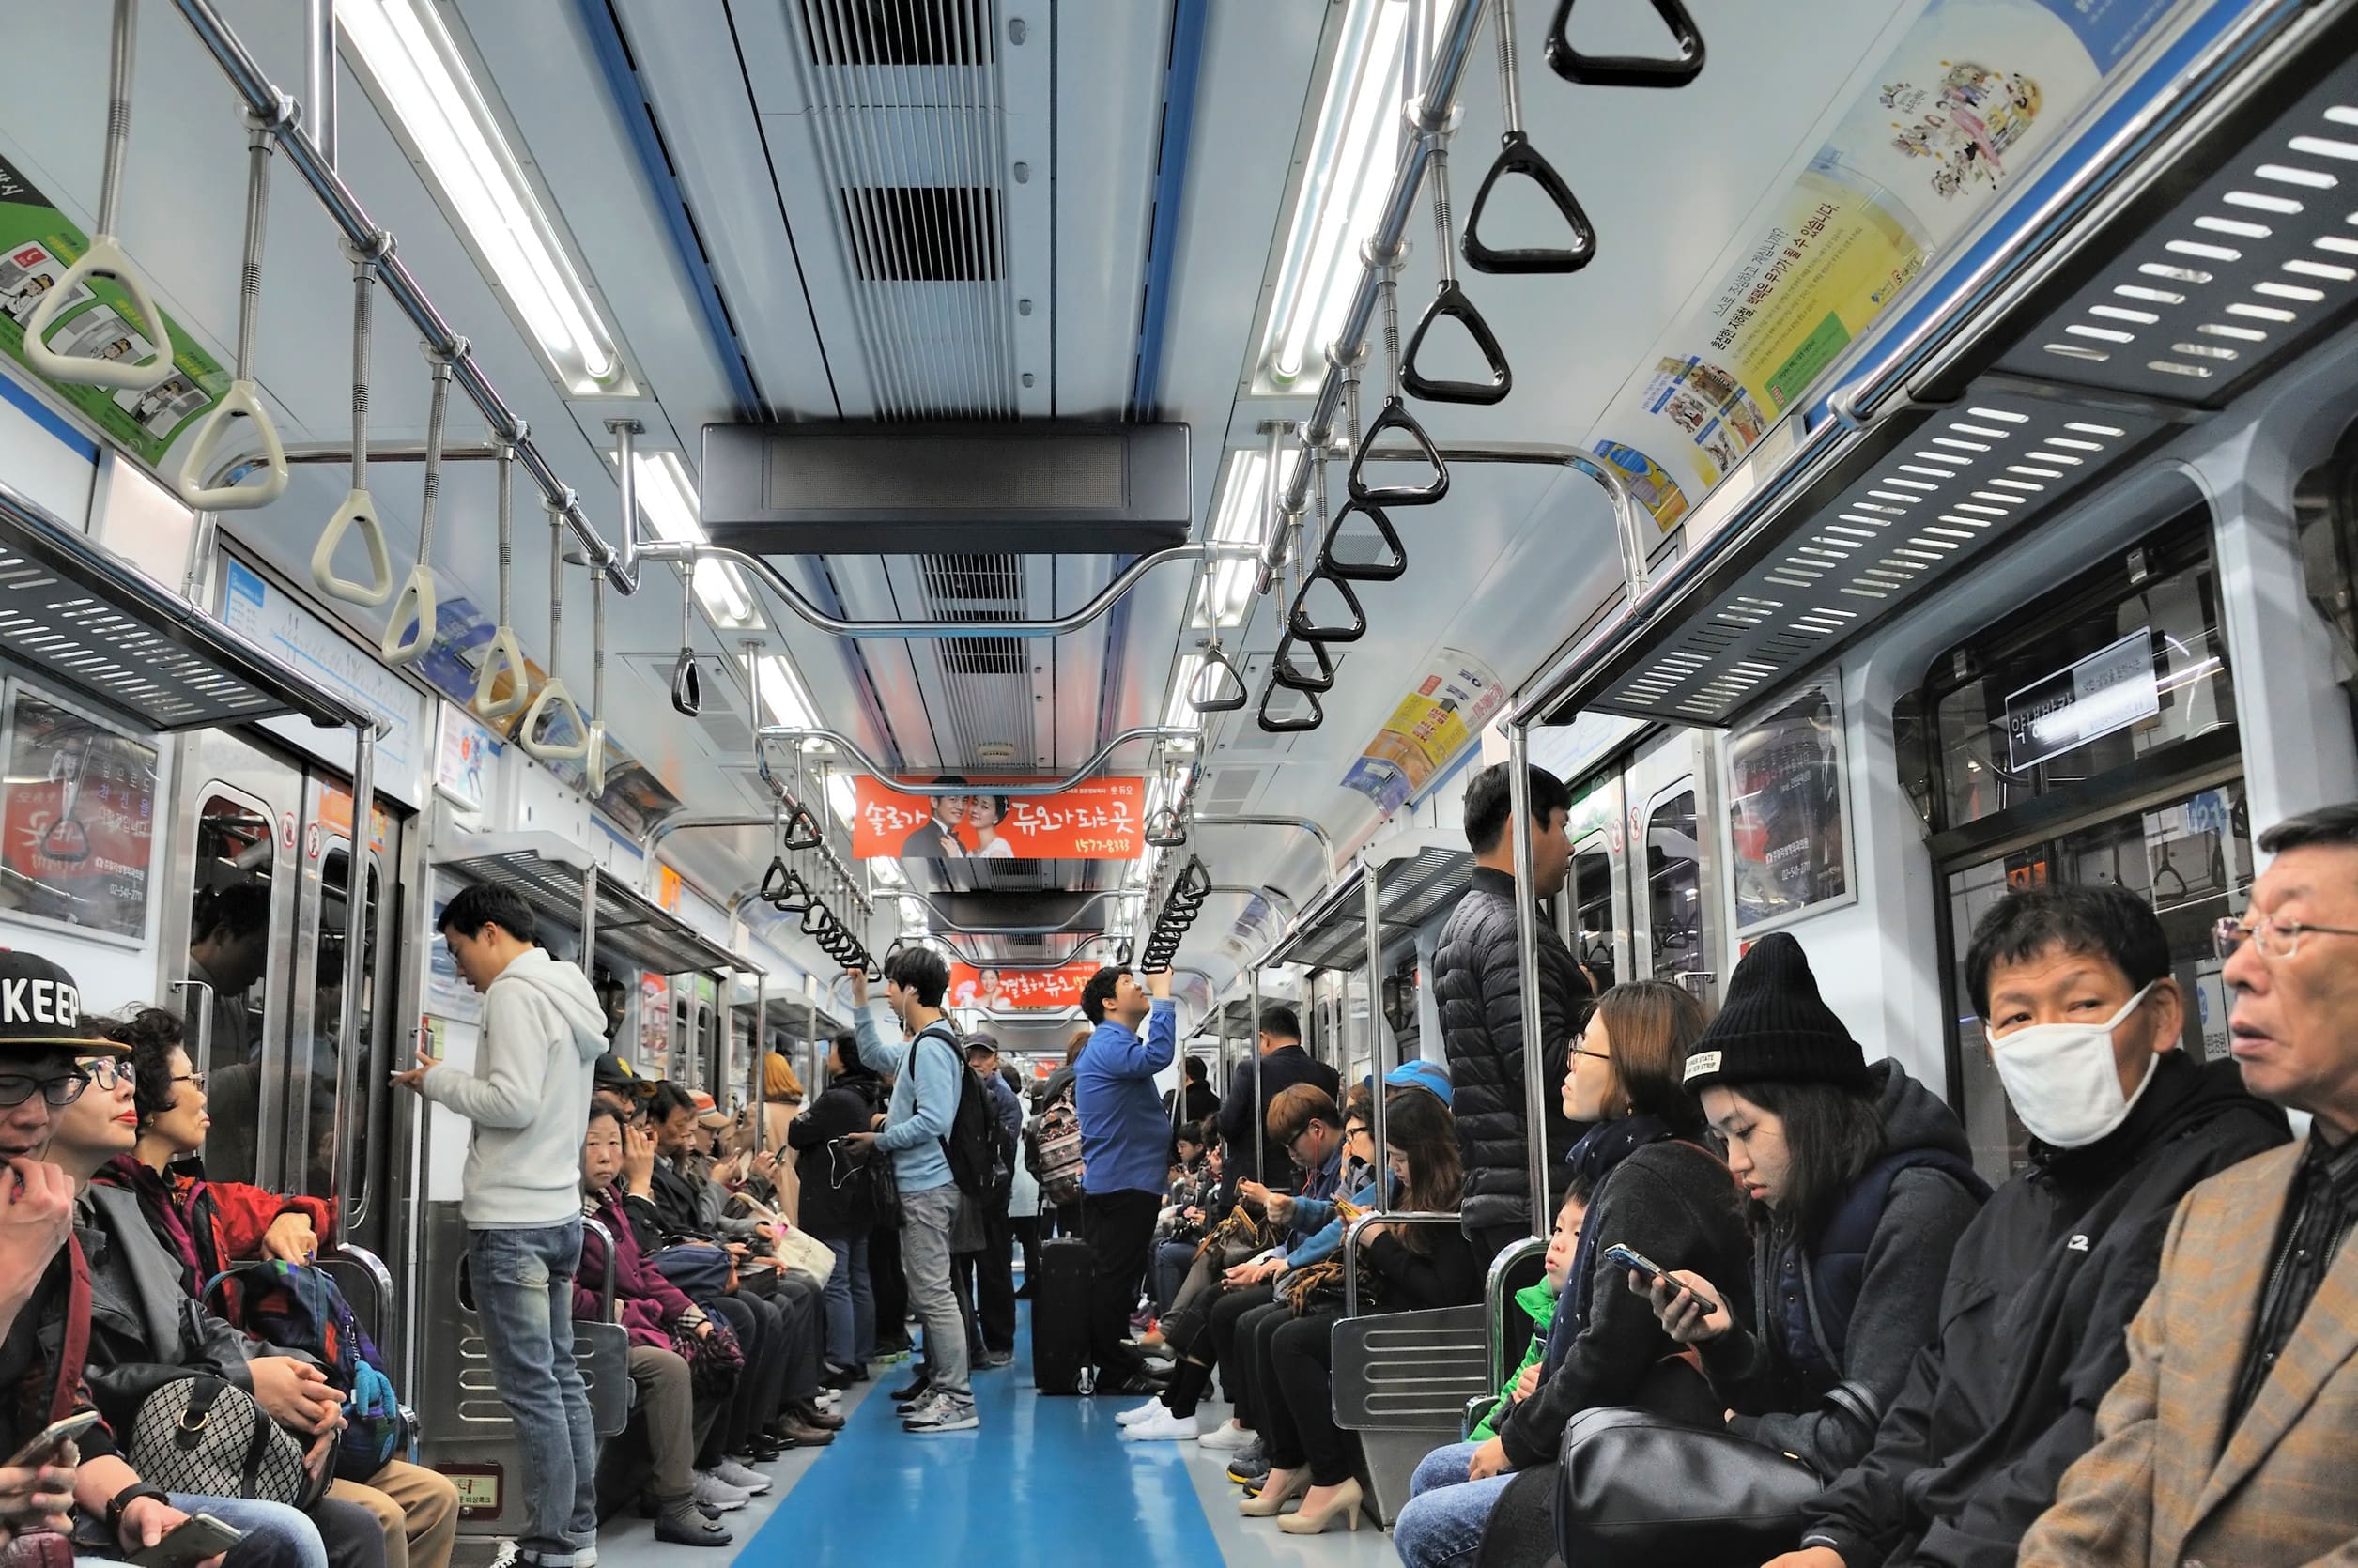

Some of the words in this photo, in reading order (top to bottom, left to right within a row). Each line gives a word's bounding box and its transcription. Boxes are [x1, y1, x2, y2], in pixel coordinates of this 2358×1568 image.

[1800, 202, 1841, 239] 있습니다.
[1794, 238, 1809, 249] 수
[1713, 295, 1736, 317] 스스로
[1729, 266, 1759, 296] 조심하고
[1757, 227, 1789, 263] 계십니까?
[1764, 257, 1794, 284] 무기가
[1747, 283, 1774, 305] 백팩은
[1710, 328, 1736, 350] 혼잡한
[865, 801, 928, 836] 솔로가
[1012, 802, 1074, 836] 듀오가
[1078, 807, 1111, 829] 되는
[1109, 801, 1134, 834] 곳
[1076, 839, 1130, 853] 1577-8333
[1000, 974, 1044, 998] 결혼해
[1042, 973, 1074, 998] 듀오
[2, 978, 80, 1028] KEEP
